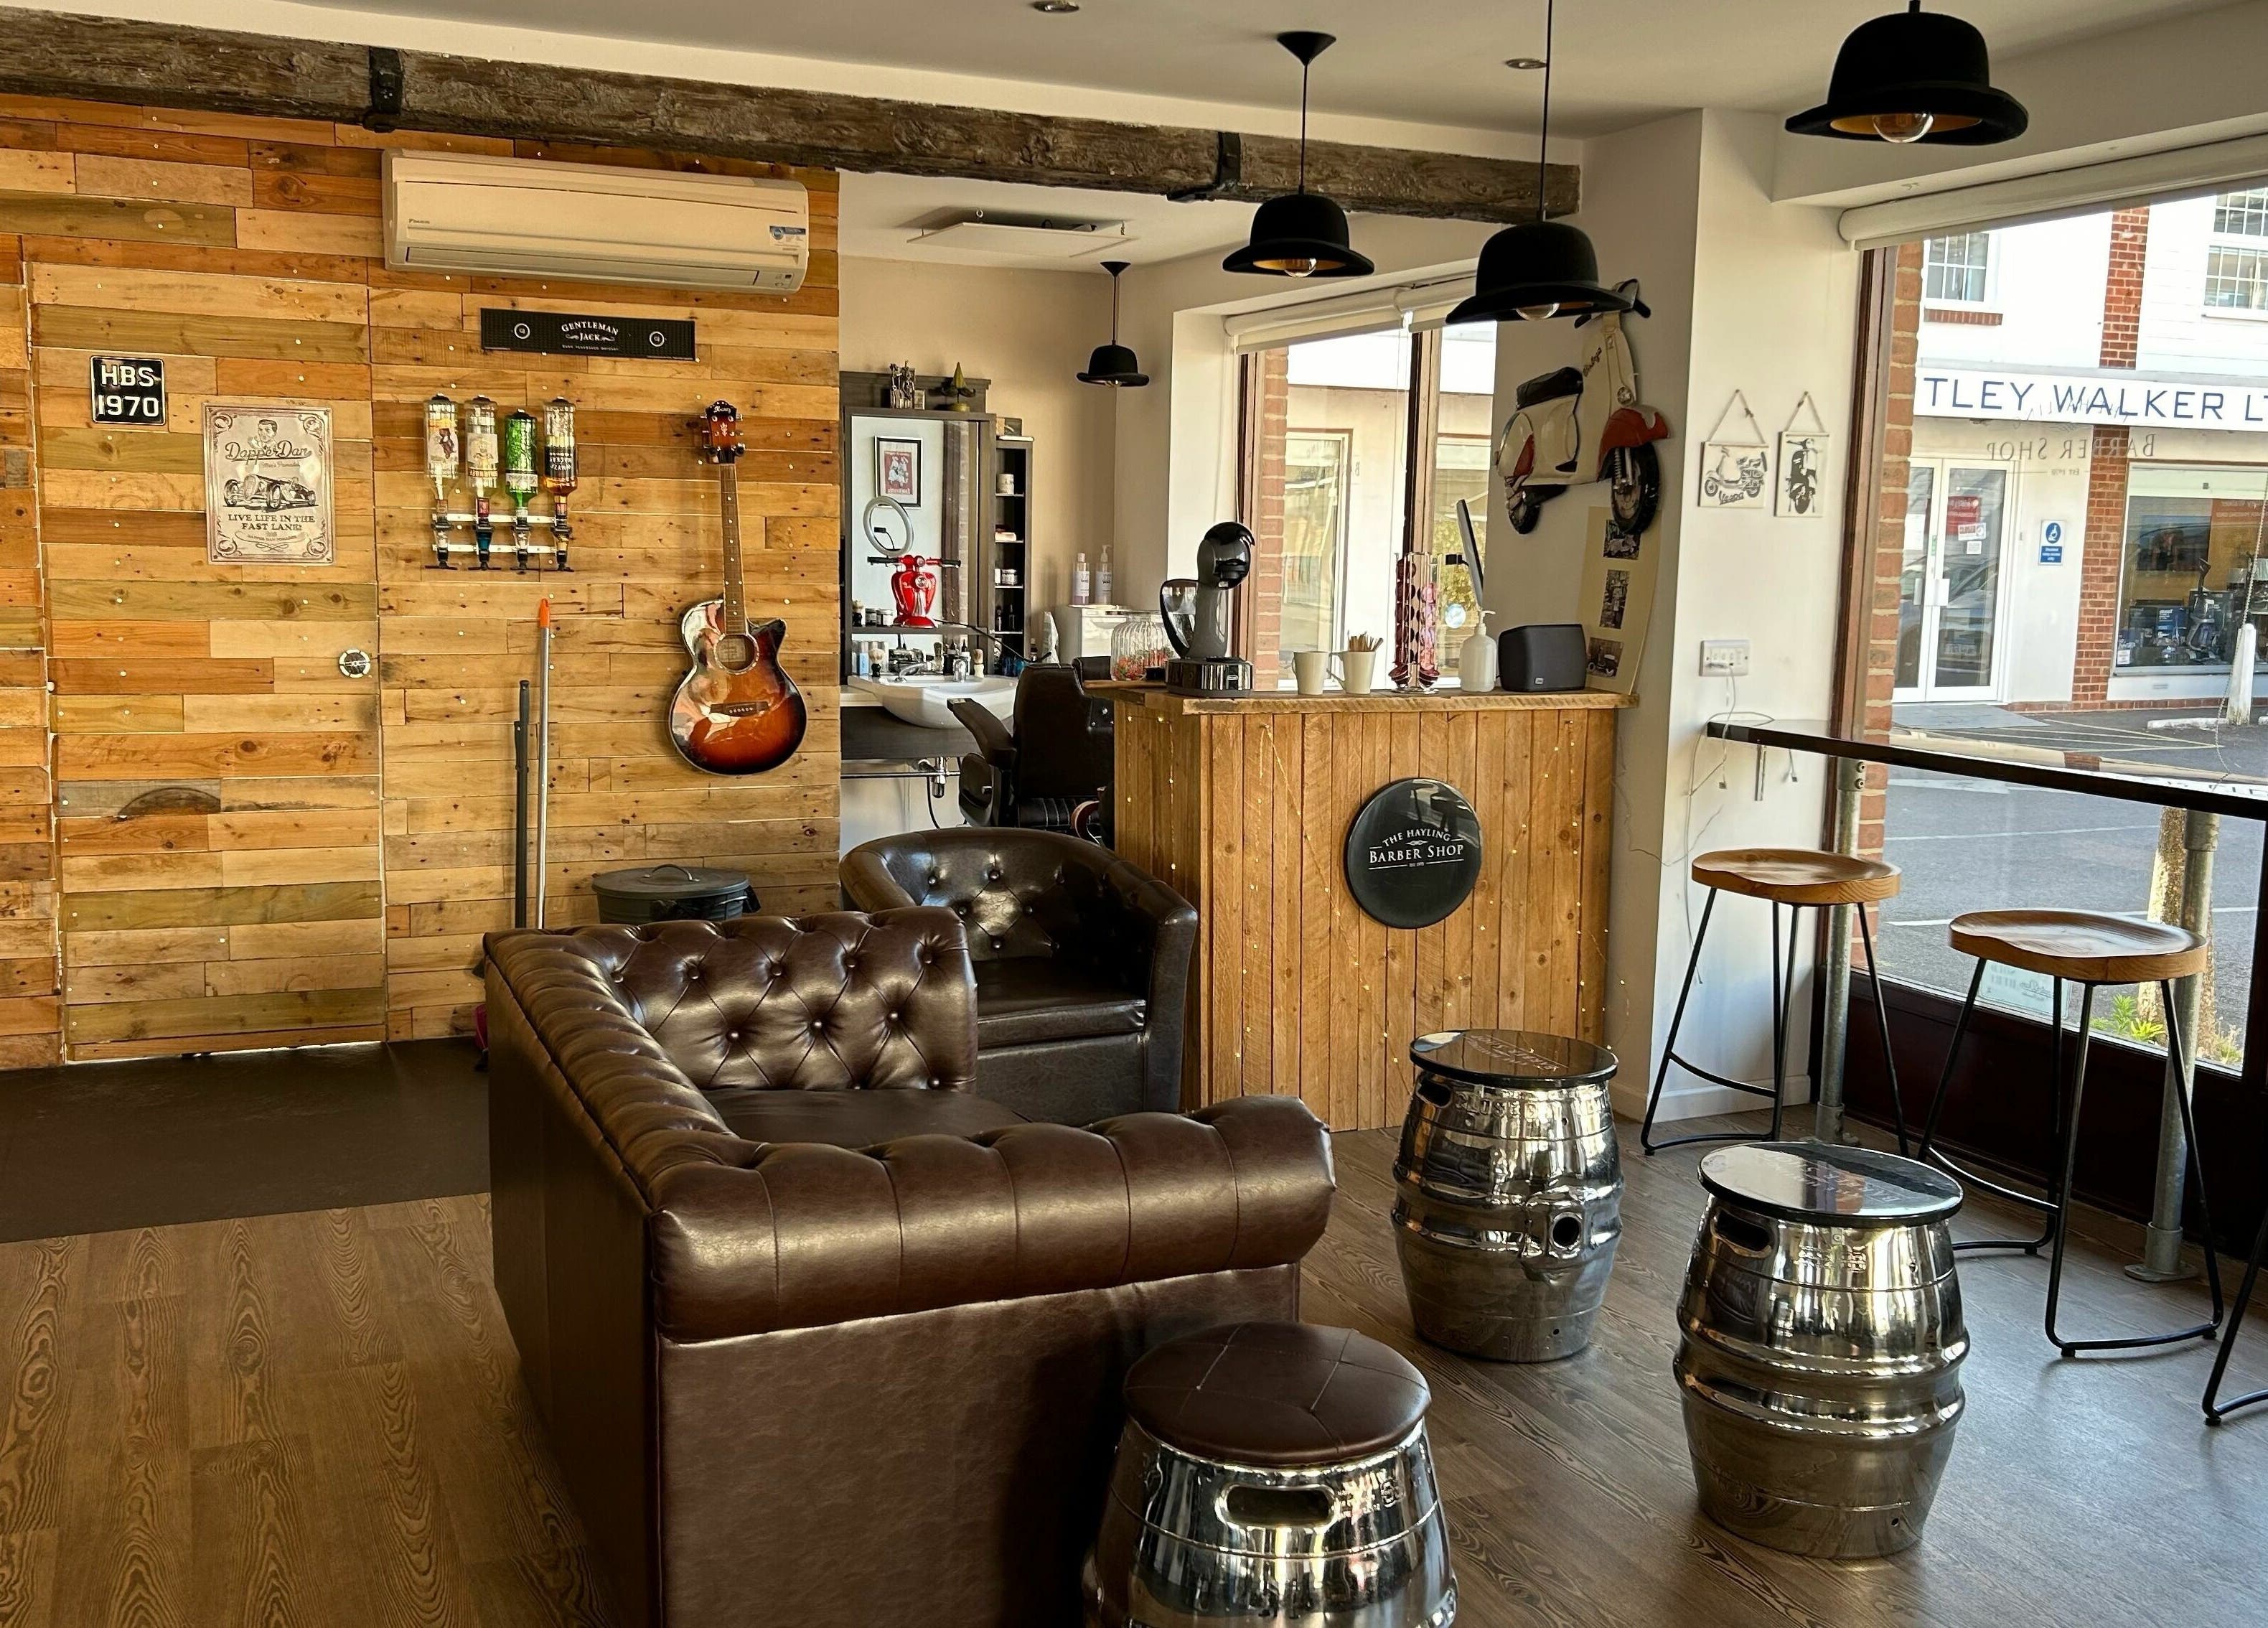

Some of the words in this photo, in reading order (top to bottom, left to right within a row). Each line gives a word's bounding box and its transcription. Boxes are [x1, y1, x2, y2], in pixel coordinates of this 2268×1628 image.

[561, 321, 619, 335] GENTLEMAN
[579, 332, 601, 341] JACK
[100, 363, 155, 388] HBS
[97, 395, 159, 417] 1970
[2053, 384, 2224, 420] WALKER
[2245, 394, 2268, 421] L
[277, 440, 312, 459] Dan
[1382, 833, 1403, 847] THE
[1407, 828, 1452, 842] HAYLING
[1369, 848, 1422, 864] BARBER
[1428, 844, 1464, 858] SHOP
